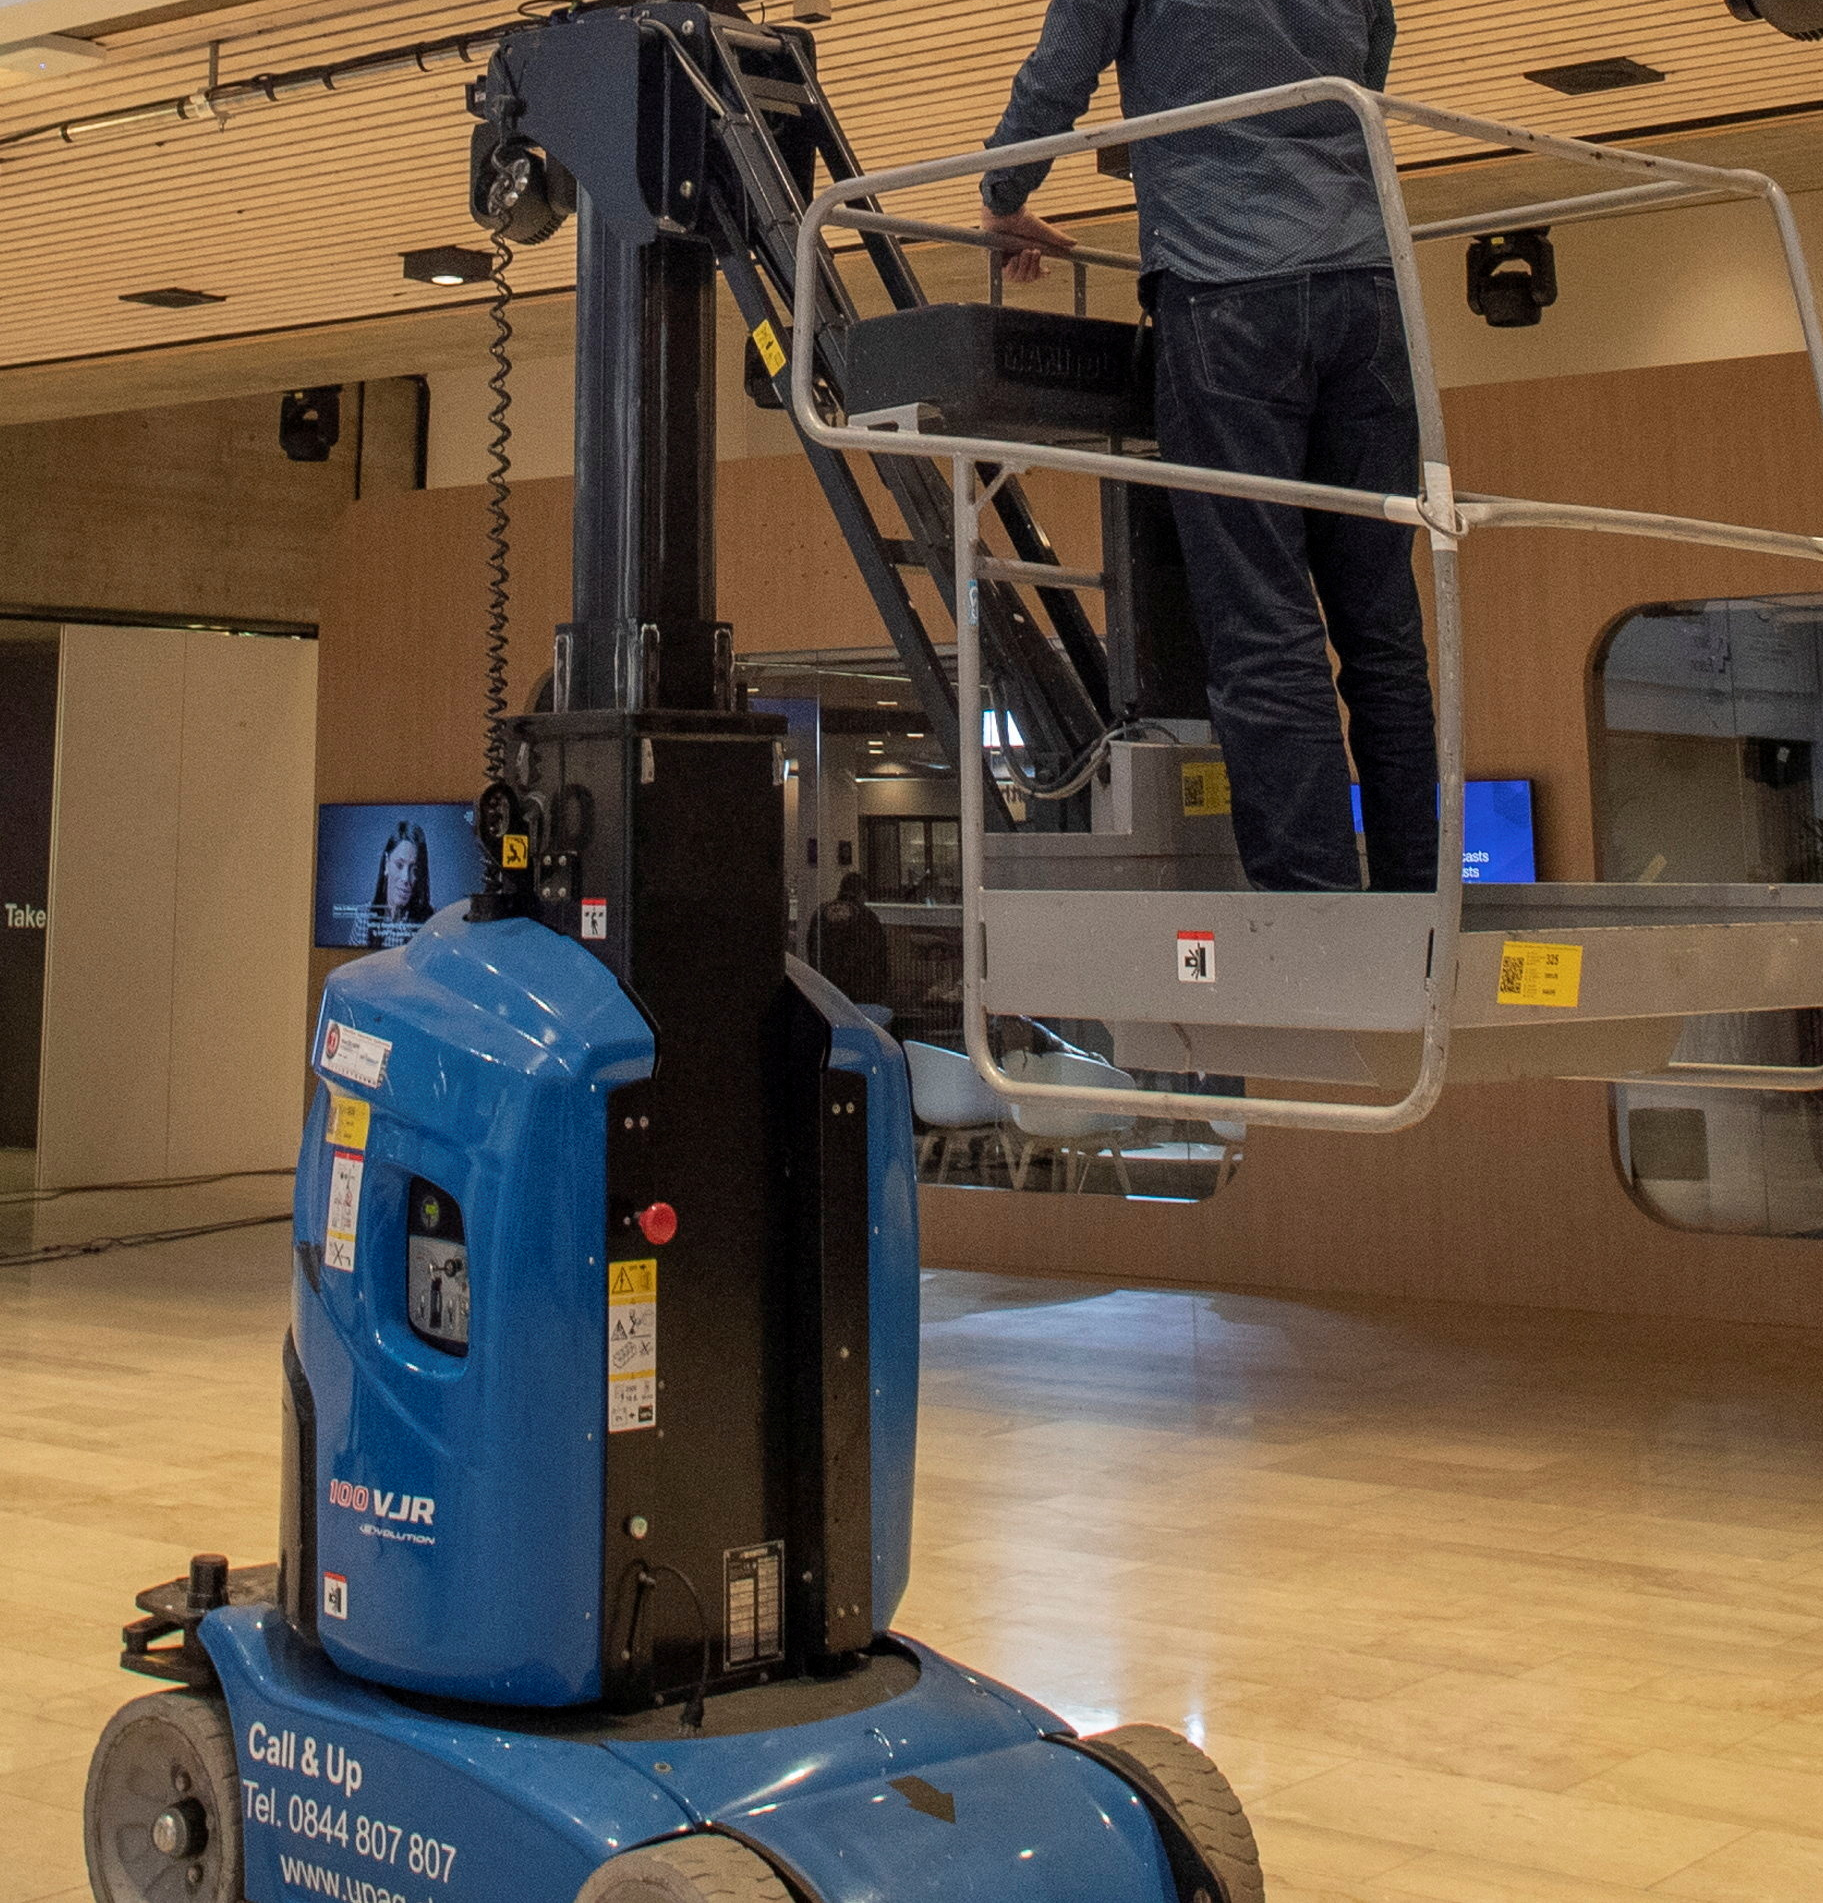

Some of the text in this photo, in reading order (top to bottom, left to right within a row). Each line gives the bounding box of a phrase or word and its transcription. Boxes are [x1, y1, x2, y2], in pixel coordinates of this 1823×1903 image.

[4, 902, 47, 929] Take
[328, 1478, 436, 1526] 100 VJR
[248, 1720, 363, 1798] Call & Up
[242, 1778, 458, 1884] Tel. 0844 807 807
